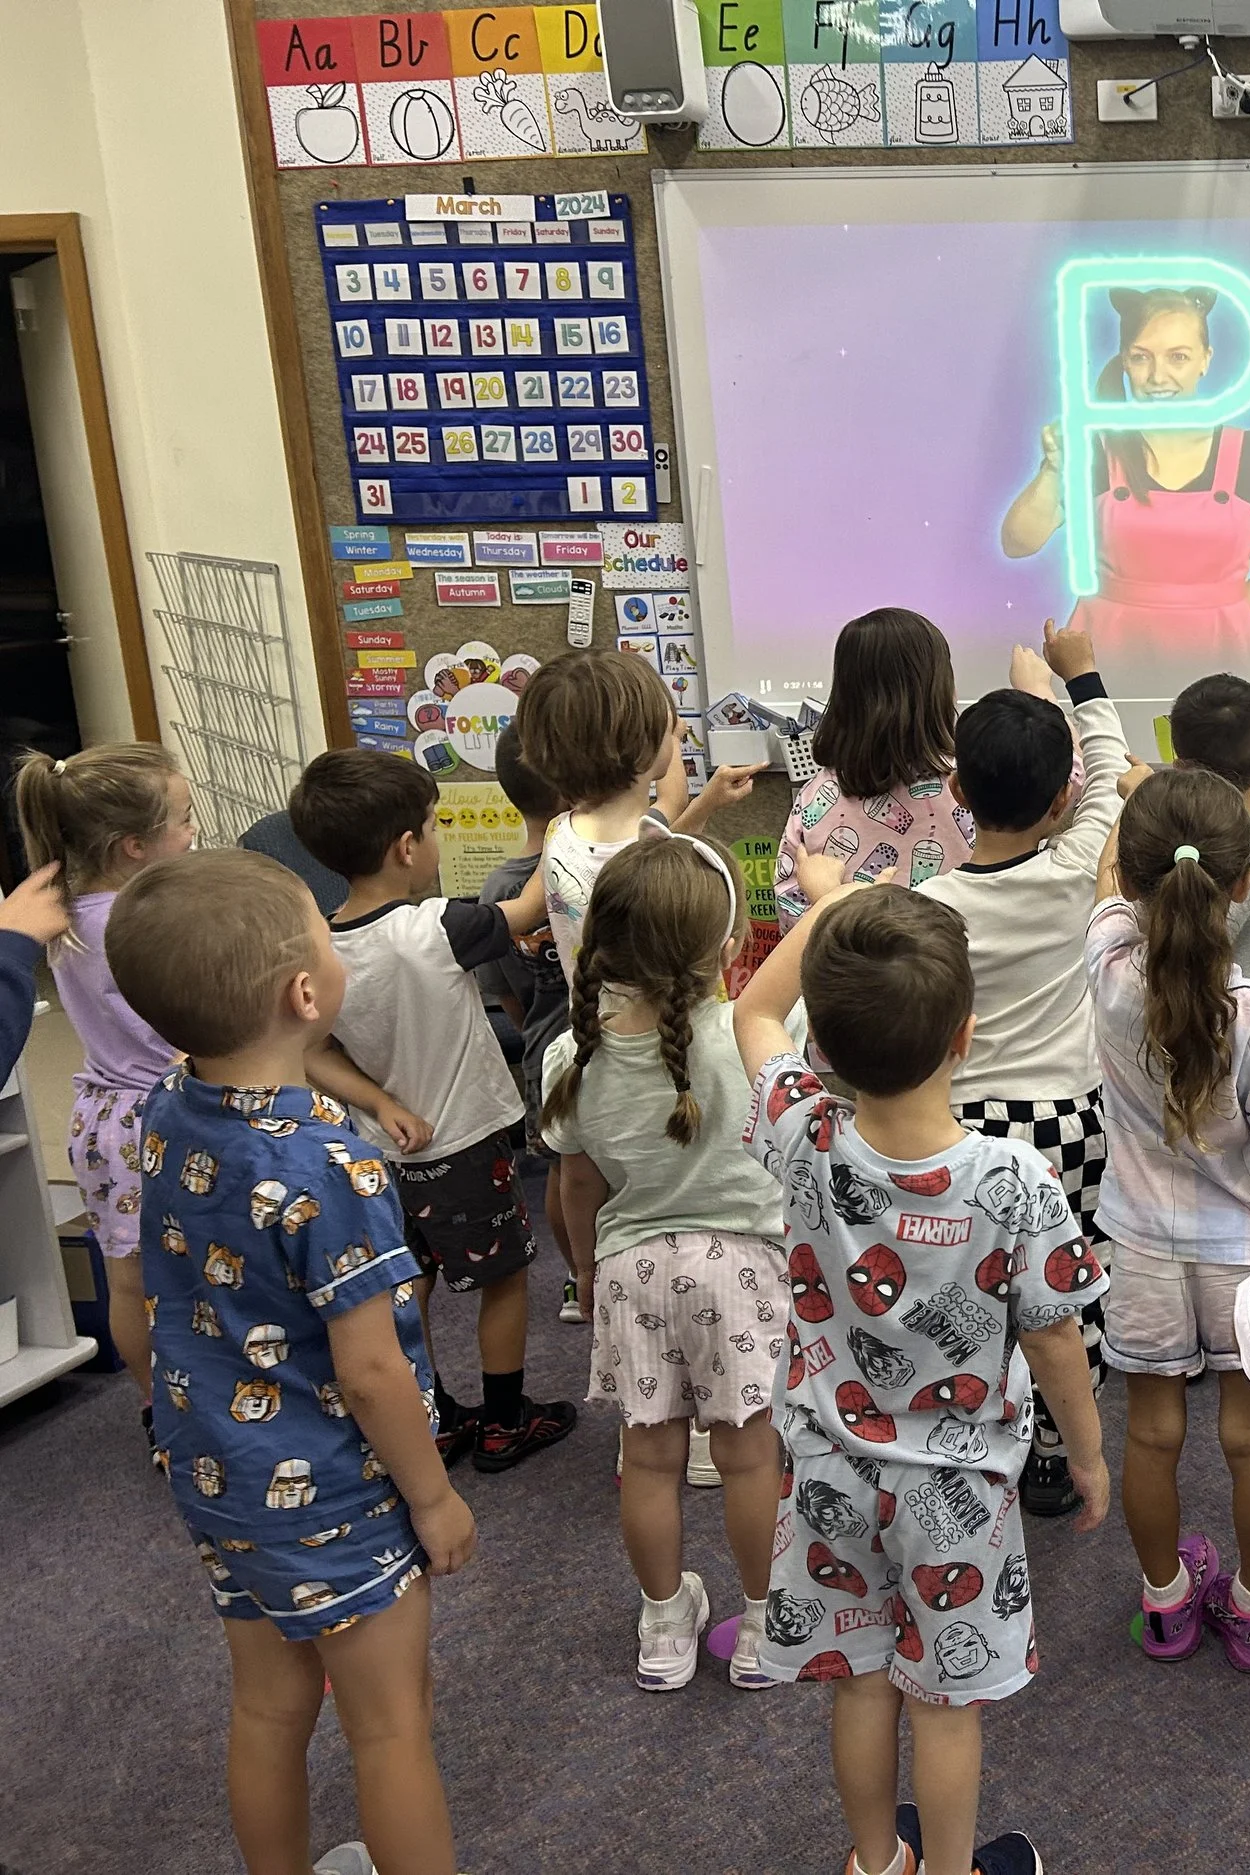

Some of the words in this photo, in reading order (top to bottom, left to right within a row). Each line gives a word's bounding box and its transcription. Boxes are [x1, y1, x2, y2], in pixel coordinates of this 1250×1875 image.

[719, 2, 760, 51] Ee
[994, 0, 1051, 46] Hh
[471, 13, 521, 62] Cc
[285, 24, 337, 71] Aa
[436, 196, 501, 216] March
[557, 193, 606, 216] 2024
[370, 229, 399, 238] Tuesday
[503, 228, 527, 237] Friday
[536, 227, 570, 236] Saturday
[593, 227, 620, 236] Sunday
[346, 269, 361, 293] 3
[383, 269, 400, 292] 4
[429, 268, 447, 292] 5
[472, 268, 487, 291] 6
[516, 268, 530, 291] 7
[555, 267, 572, 291] 8
[598, 266, 615, 290] 9
[343, 326, 364, 348] 10
[399, 324, 410, 346] 11
[431, 324, 453, 347] 12
[476, 325, 496, 347] 13
[512, 324, 533, 346] 14
[561, 324, 582, 347] 15
[599, 321, 621, 345] 16
[359, 380, 377, 402] 17
[396, 378, 419, 401] 18
[444, 377, 465, 400] 19
[475, 377, 504, 400] 20
[522, 376, 544, 399] 21
[560, 376, 591, 399] 22
[606, 375, 636, 399] 23
[357, 432, 385, 455] 24
[396, 432, 426, 455] 25
[444, 431, 475, 455] 26
[484, 430, 512, 453] 27
[525, 430, 553, 454] 28
[570, 430, 600, 452] 29
[612, 429, 642, 452] 30
[367, 484, 385, 507] 31
[581, 482, 588, 504] 1
[621, 482, 636, 505] 2
[343, 530, 375, 541] Spring
[486, 532, 511, 542] Today
[624, 530, 661, 549] Our
[345, 546, 378, 555] Winter
[407, 547, 463, 558] Wednesday
[482, 546, 527, 557] Thursday
[555, 545, 589, 556] Friday
[603, 554, 689, 573] Schedule
[363, 567, 402, 577] Monday
[511, 570, 524, 578] The
[526, 570, 559, 578] weather
[437, 575, 452, 583] The
[350, 584, 393, 595] Saturday
[449, 588, 485, 597] Autumn
[537, 585, 569, 594] Cloudy
[353, 604, 393, 616] Tuesday
[358, 636, 392, 646] Sunday
[366, 656, 405, 664] Summer
[372, 668, 398, 677] Mostly
[375, 674, 397, 683] Sunny
[366, 683, 401, 693] Stormy
[374, 721, 399, 733] Rainy
[745, 842, 750, 856] I
[754, 842, 772, 856] AM
[897, 1213, 972, 1246] MARVEL
